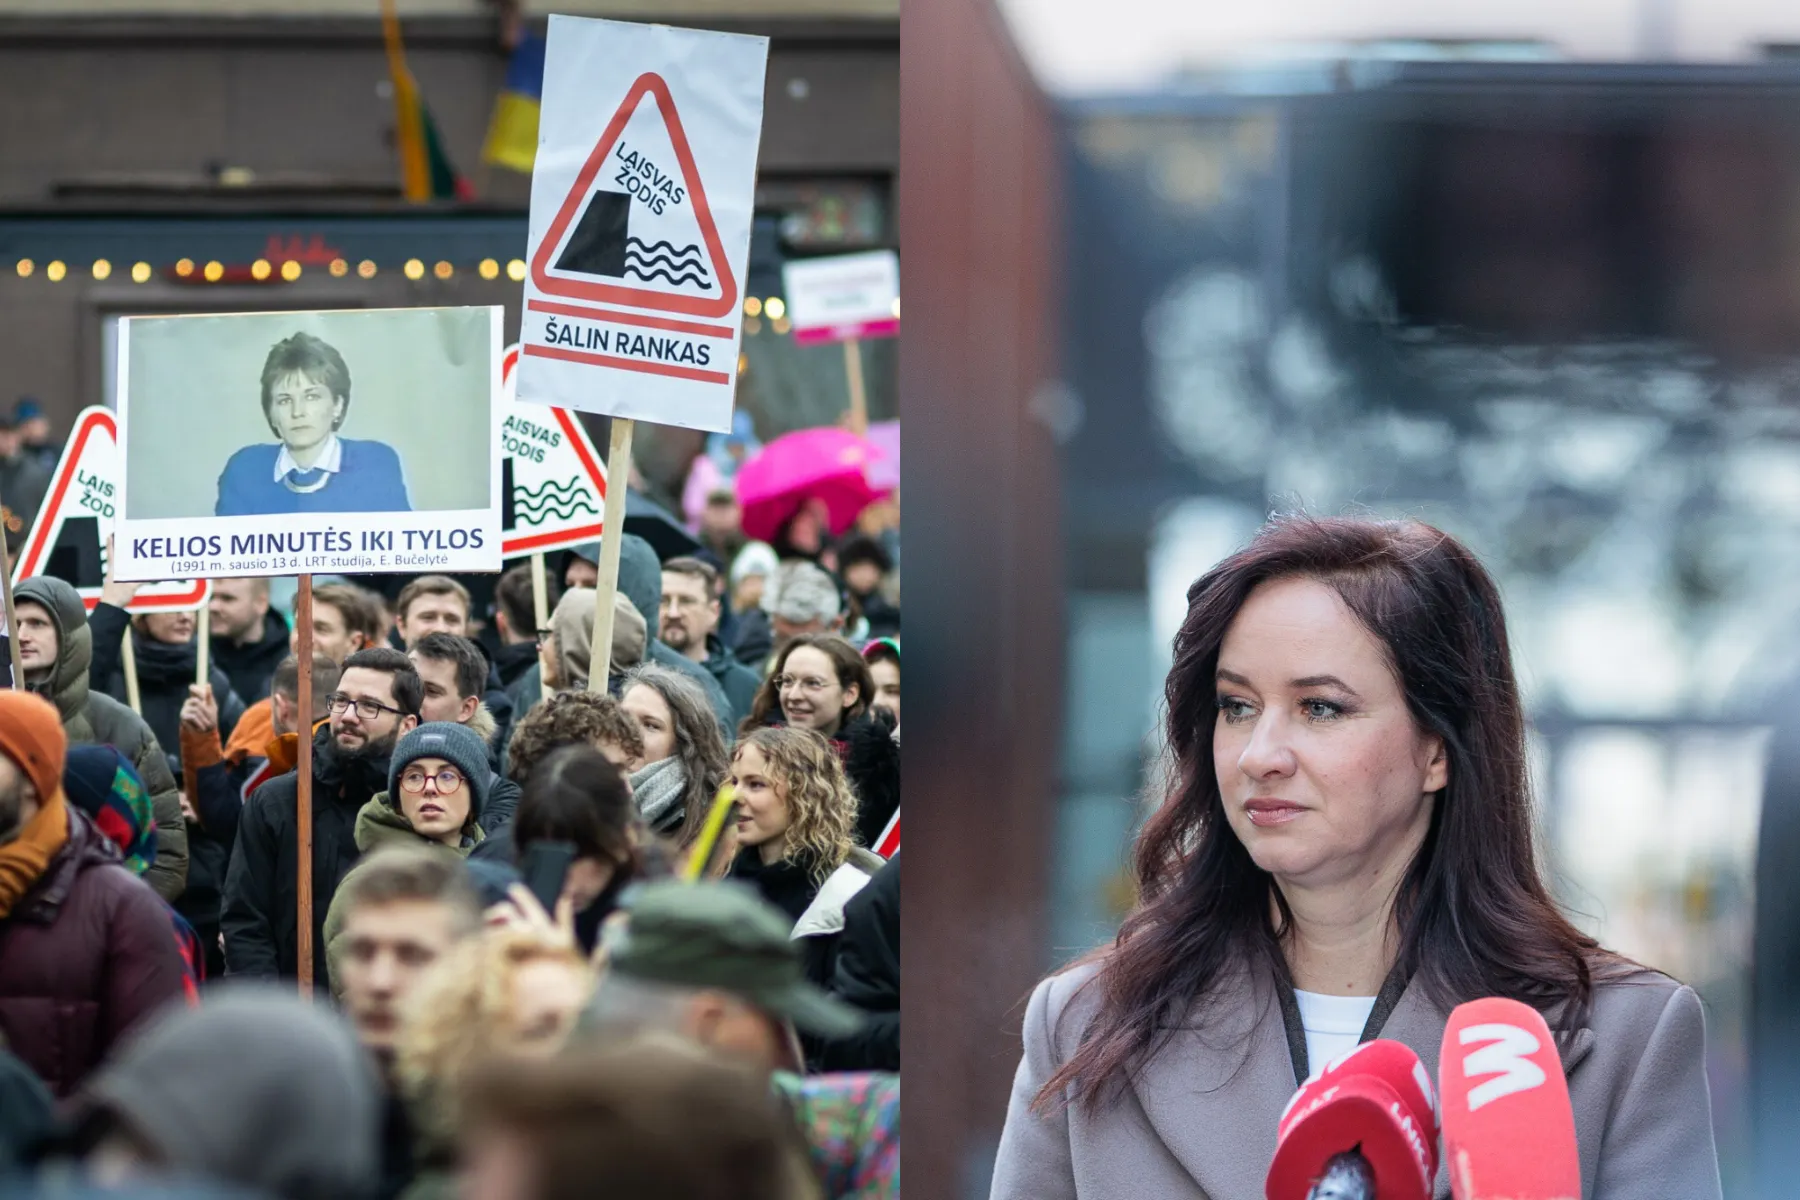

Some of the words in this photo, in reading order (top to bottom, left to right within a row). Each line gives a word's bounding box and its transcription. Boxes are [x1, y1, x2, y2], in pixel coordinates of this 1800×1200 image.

[614, 162, 667, 216] ŽODIS
[616, 141, 685, 205] LAISVAS
[545, 316, 609, 351] ŠALIN
[615, 332, 711, 366] RANKAS
[502, 415, 561, 447] AISVAS
[77, 469, 115, 498] LAIS
[79, 488, 116, 518] ŽOD
[133, 535, 222, 559] KELIOS
[231, 526, 352, 555] MINUTĖS
[361, 530, 393, 551] IKI
[402, 528, 484, 550] TYLOS
[171, 560, 206, 574] (1991
[210, 562, 225, 571] m.
[229, 558, 268, 570] sausio
[272, 558, 286, 569] 13
[290, 556, 301, 567] d.
[305, 556, 327, 567] LRT
[331, 554, 376, 568] studija,
[380, 555, 391, 566] E.
[395, 553, 448, 567] Bučelytė
